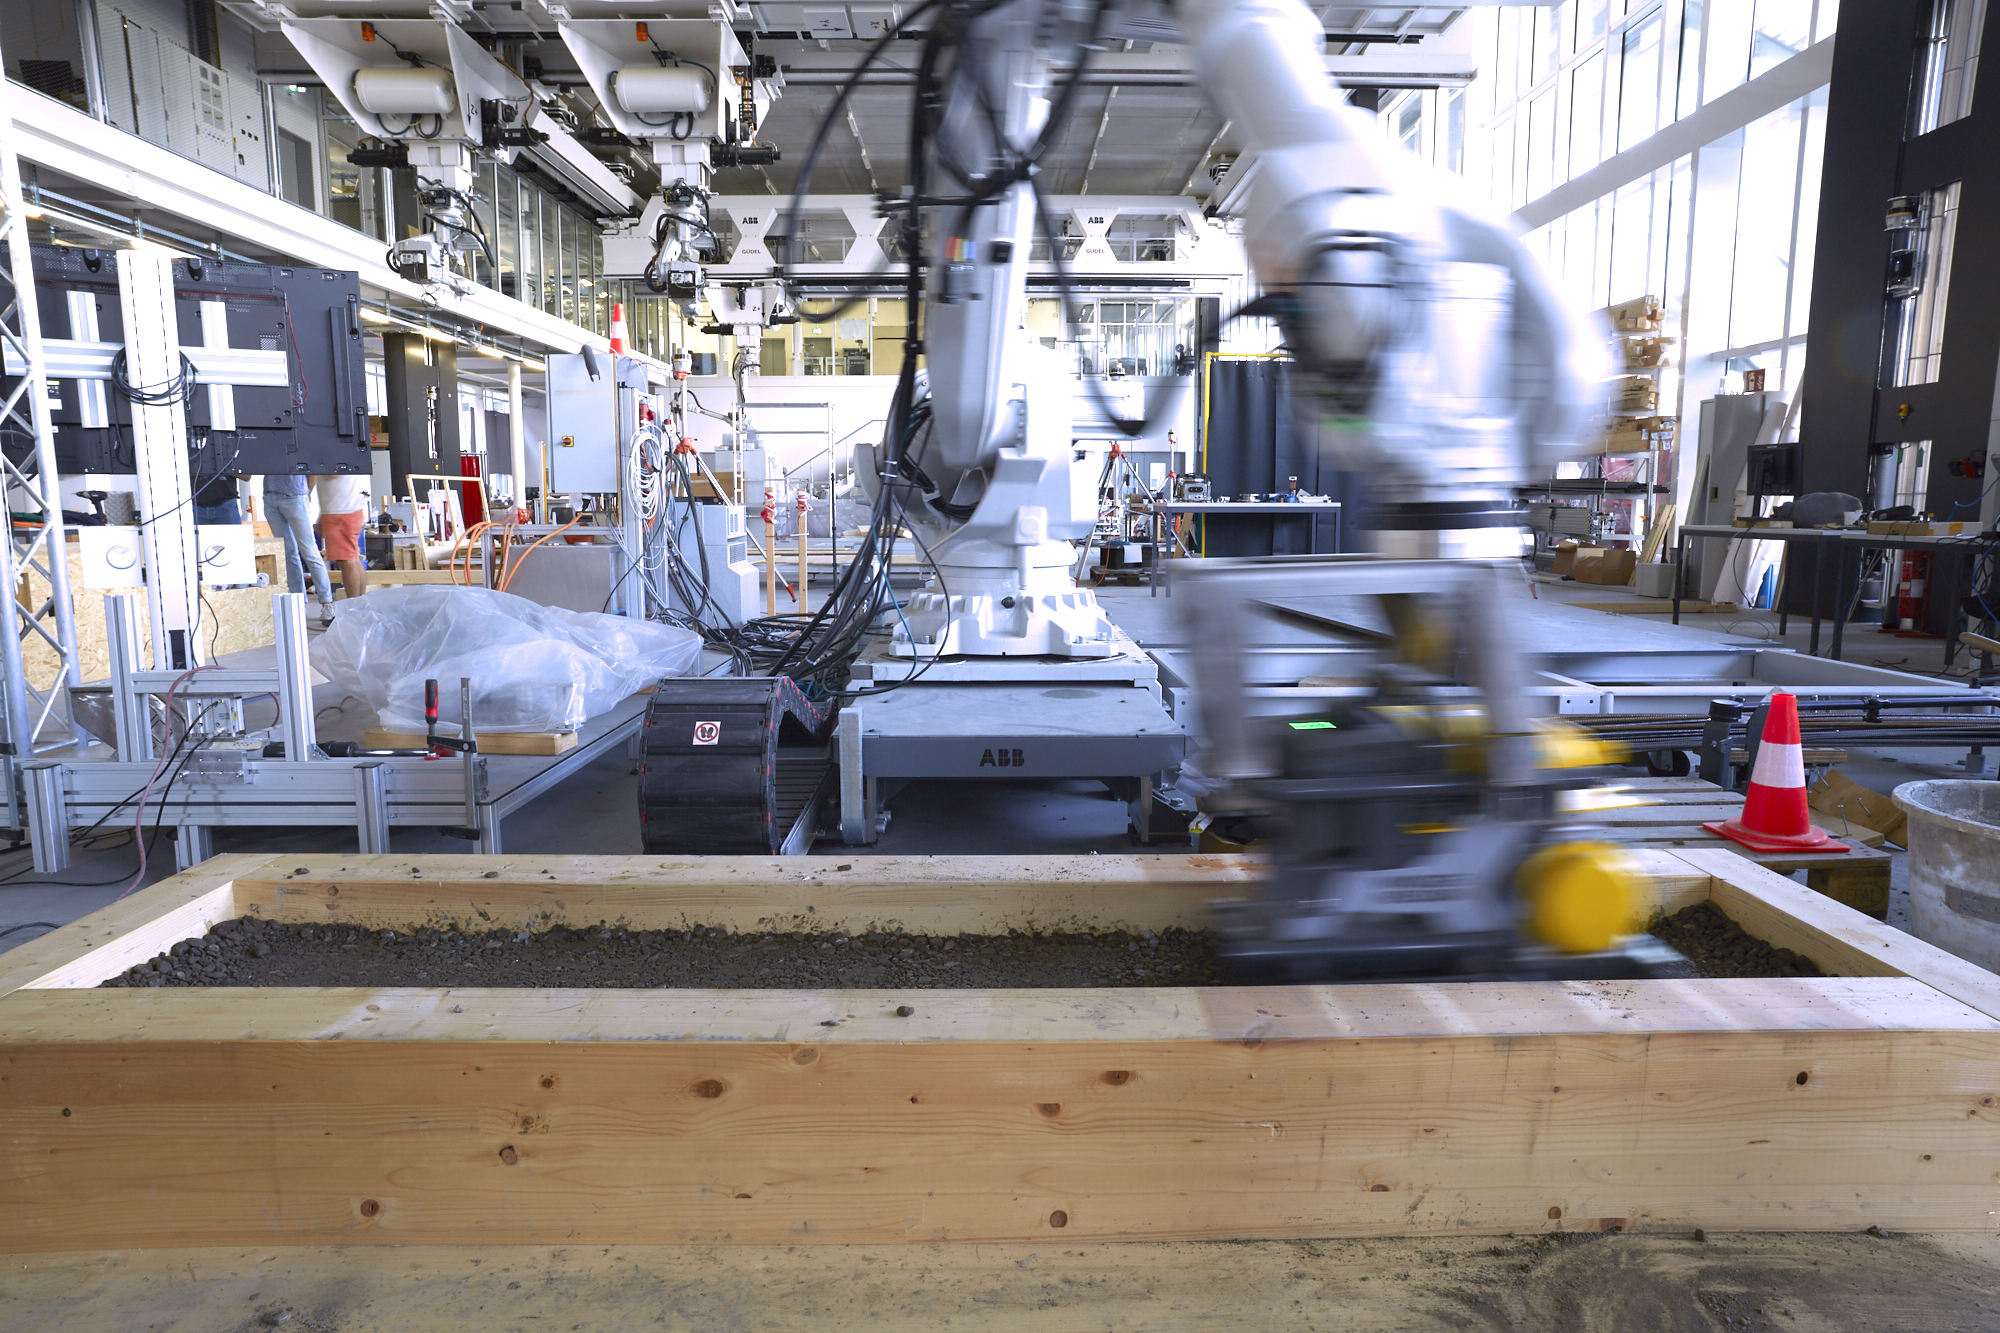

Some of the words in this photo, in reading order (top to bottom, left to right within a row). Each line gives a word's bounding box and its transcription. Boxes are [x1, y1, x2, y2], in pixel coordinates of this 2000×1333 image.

[742, 216, 758, 225] ABB
[1087, 216, 1104, 224] ABB
[979, 748, 1025, 767] ABB
[1846, 888, 1877, 903] EPAL
